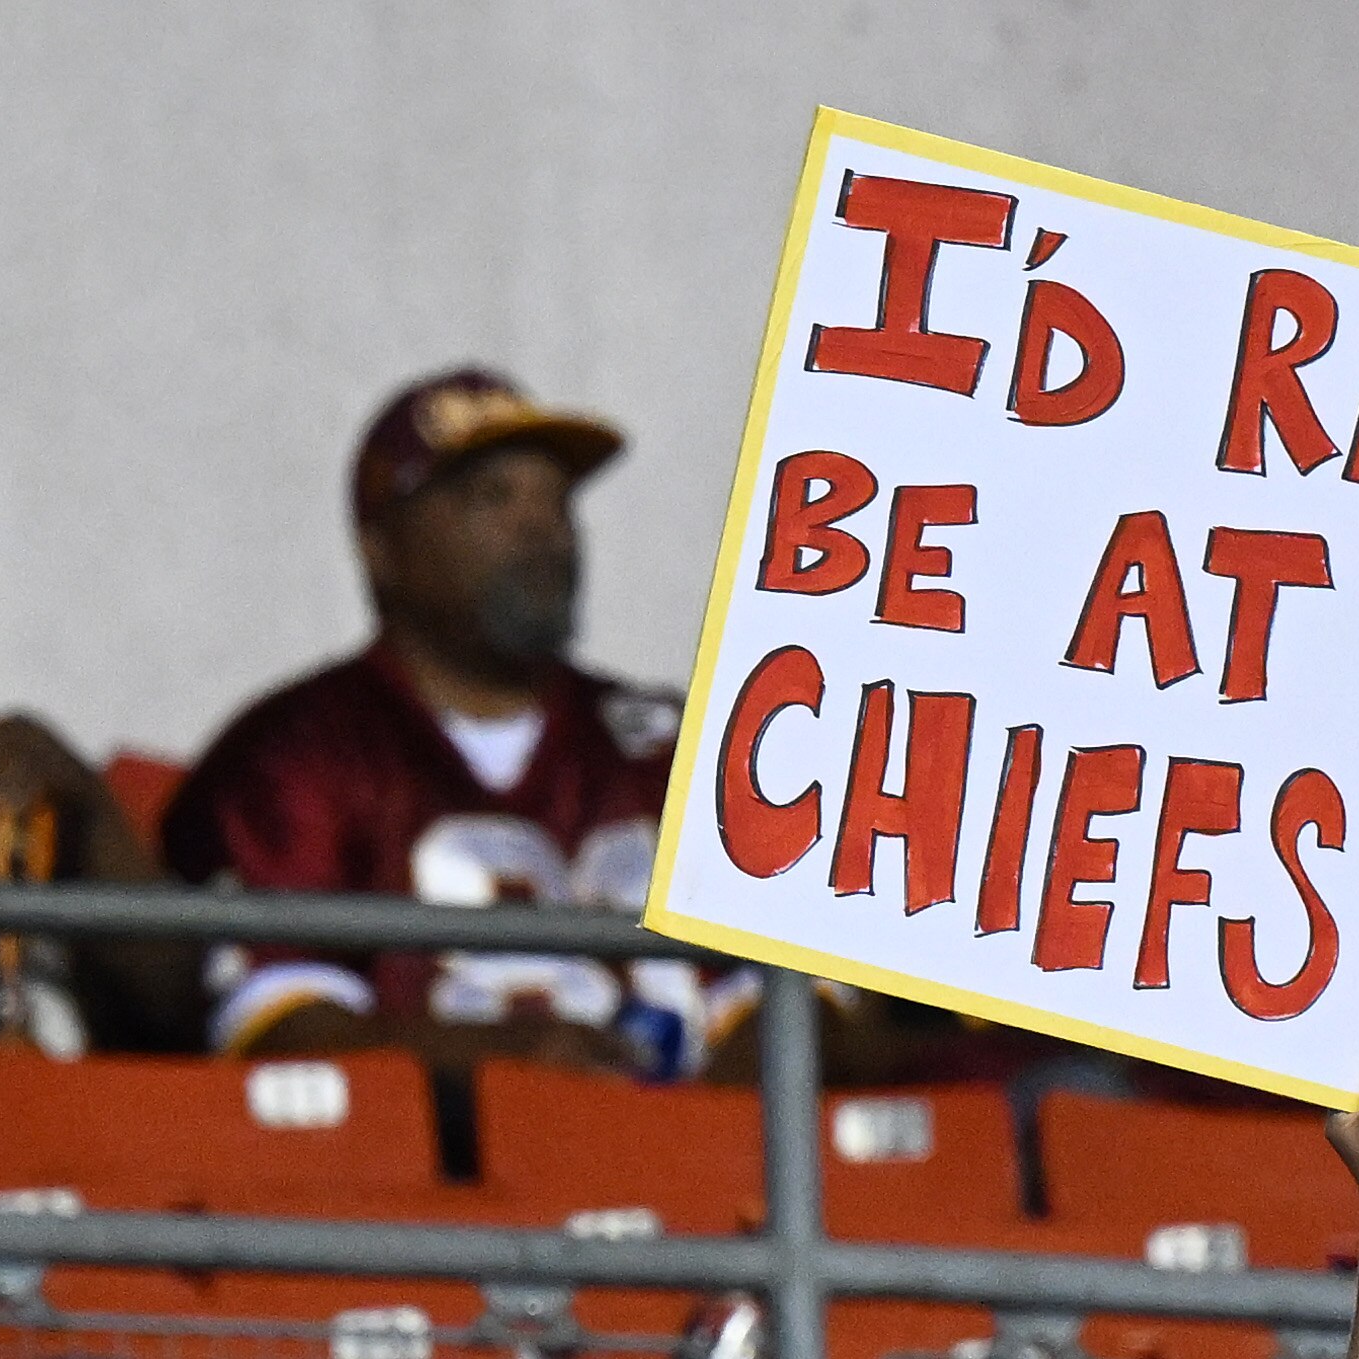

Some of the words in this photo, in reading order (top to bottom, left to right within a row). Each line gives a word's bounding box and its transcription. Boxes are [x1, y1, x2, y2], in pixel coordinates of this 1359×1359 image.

[805, 168, 1126, 427] I'D
[756, 450, 978, 633] BE
[1058, 510, 1336, 704] AT
[715, 645, 1347, 1021] CHIEFS
